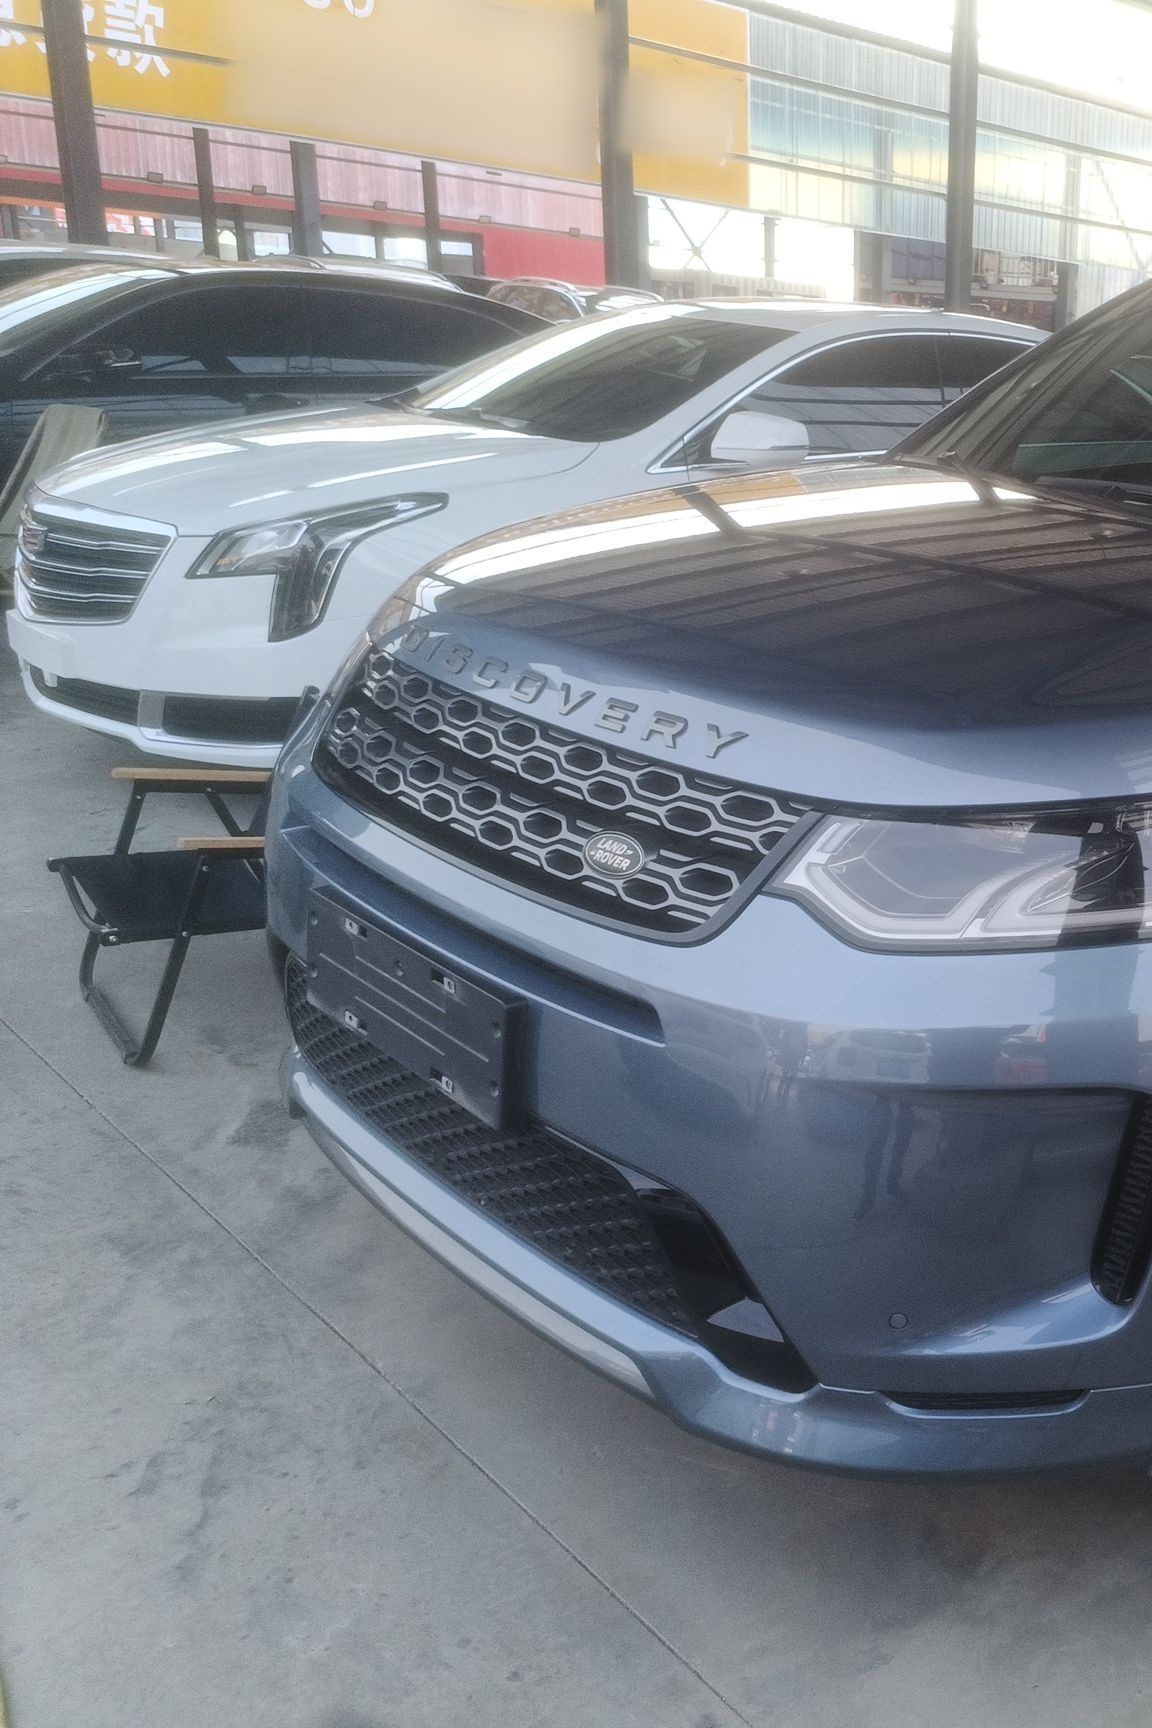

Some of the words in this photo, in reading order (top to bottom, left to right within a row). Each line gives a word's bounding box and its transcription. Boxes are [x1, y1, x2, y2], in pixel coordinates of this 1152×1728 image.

[401, 625, 749, 758] DISCOVERY
[597, 838, 627, 855] LAND
[593, 849, 630, 870] ROVER
